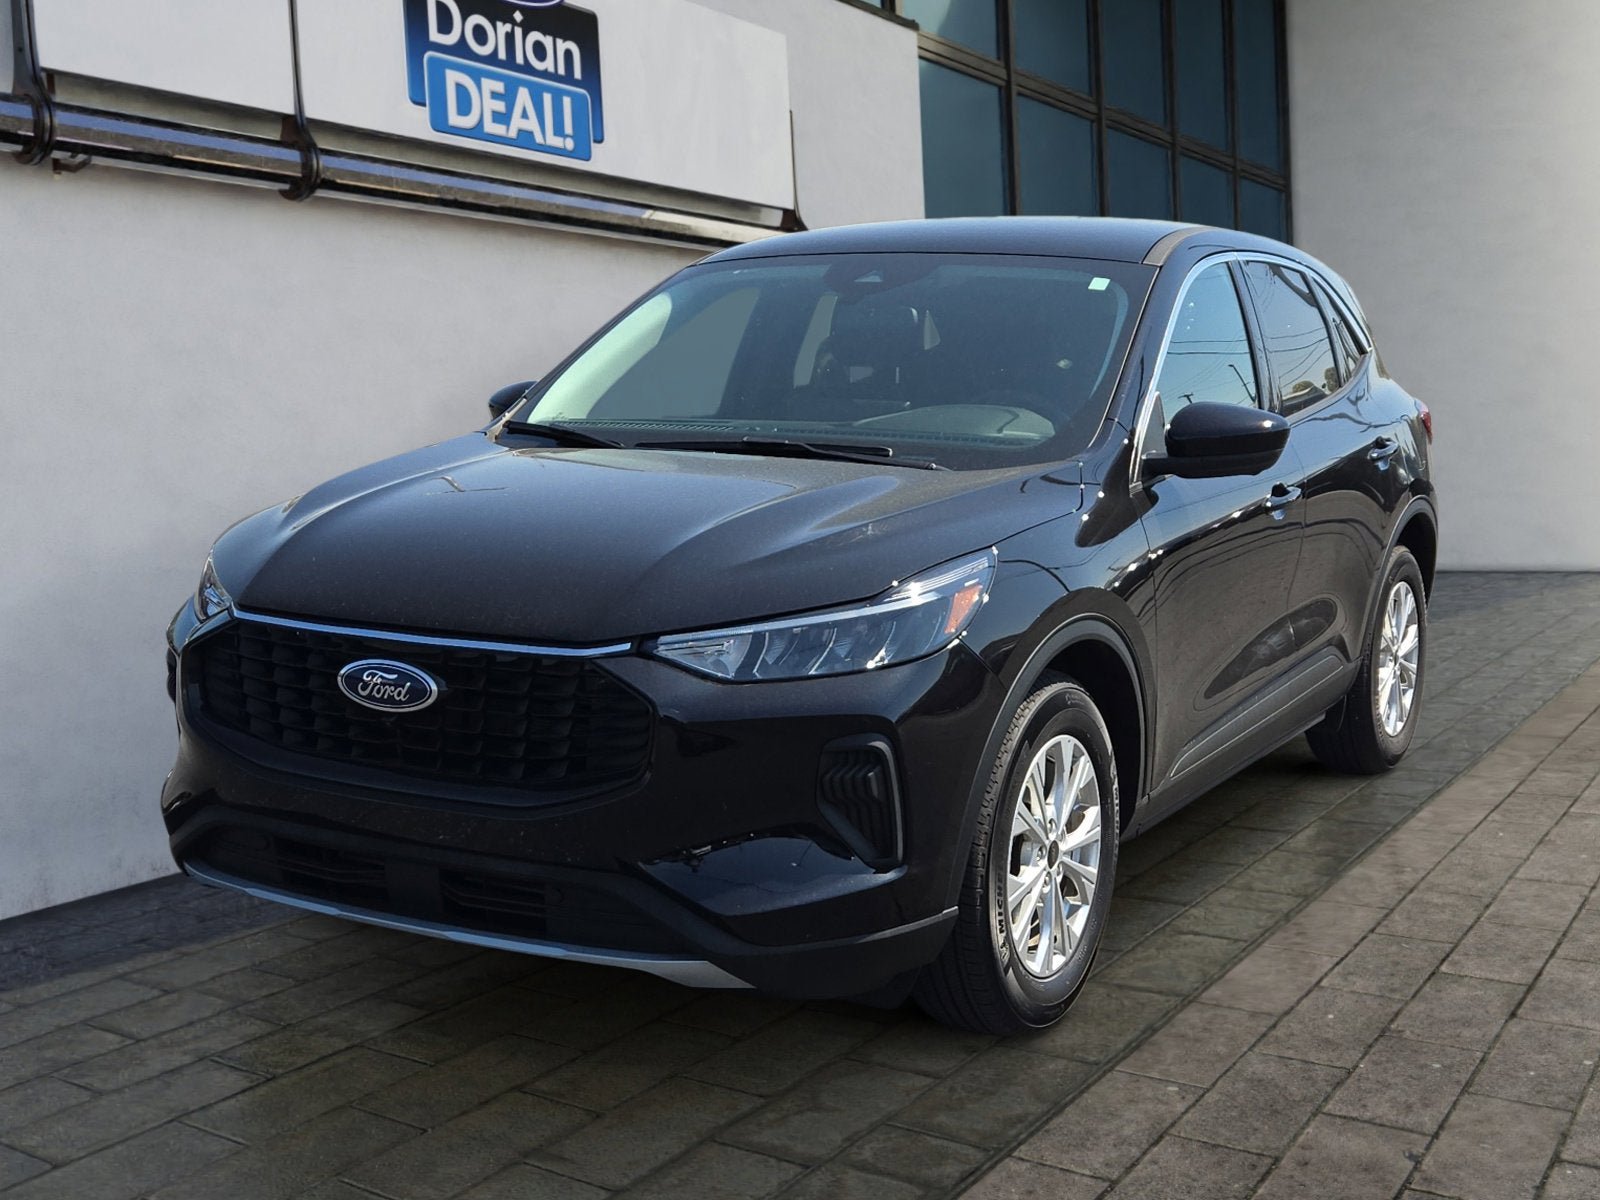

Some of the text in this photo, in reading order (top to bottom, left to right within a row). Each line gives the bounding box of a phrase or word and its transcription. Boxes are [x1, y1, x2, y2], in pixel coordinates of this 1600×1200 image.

[427, 0, 582, 80] Dorian
[445, 68, 575, 151] DEAL!
[358, 669, 411, 702] Ford
